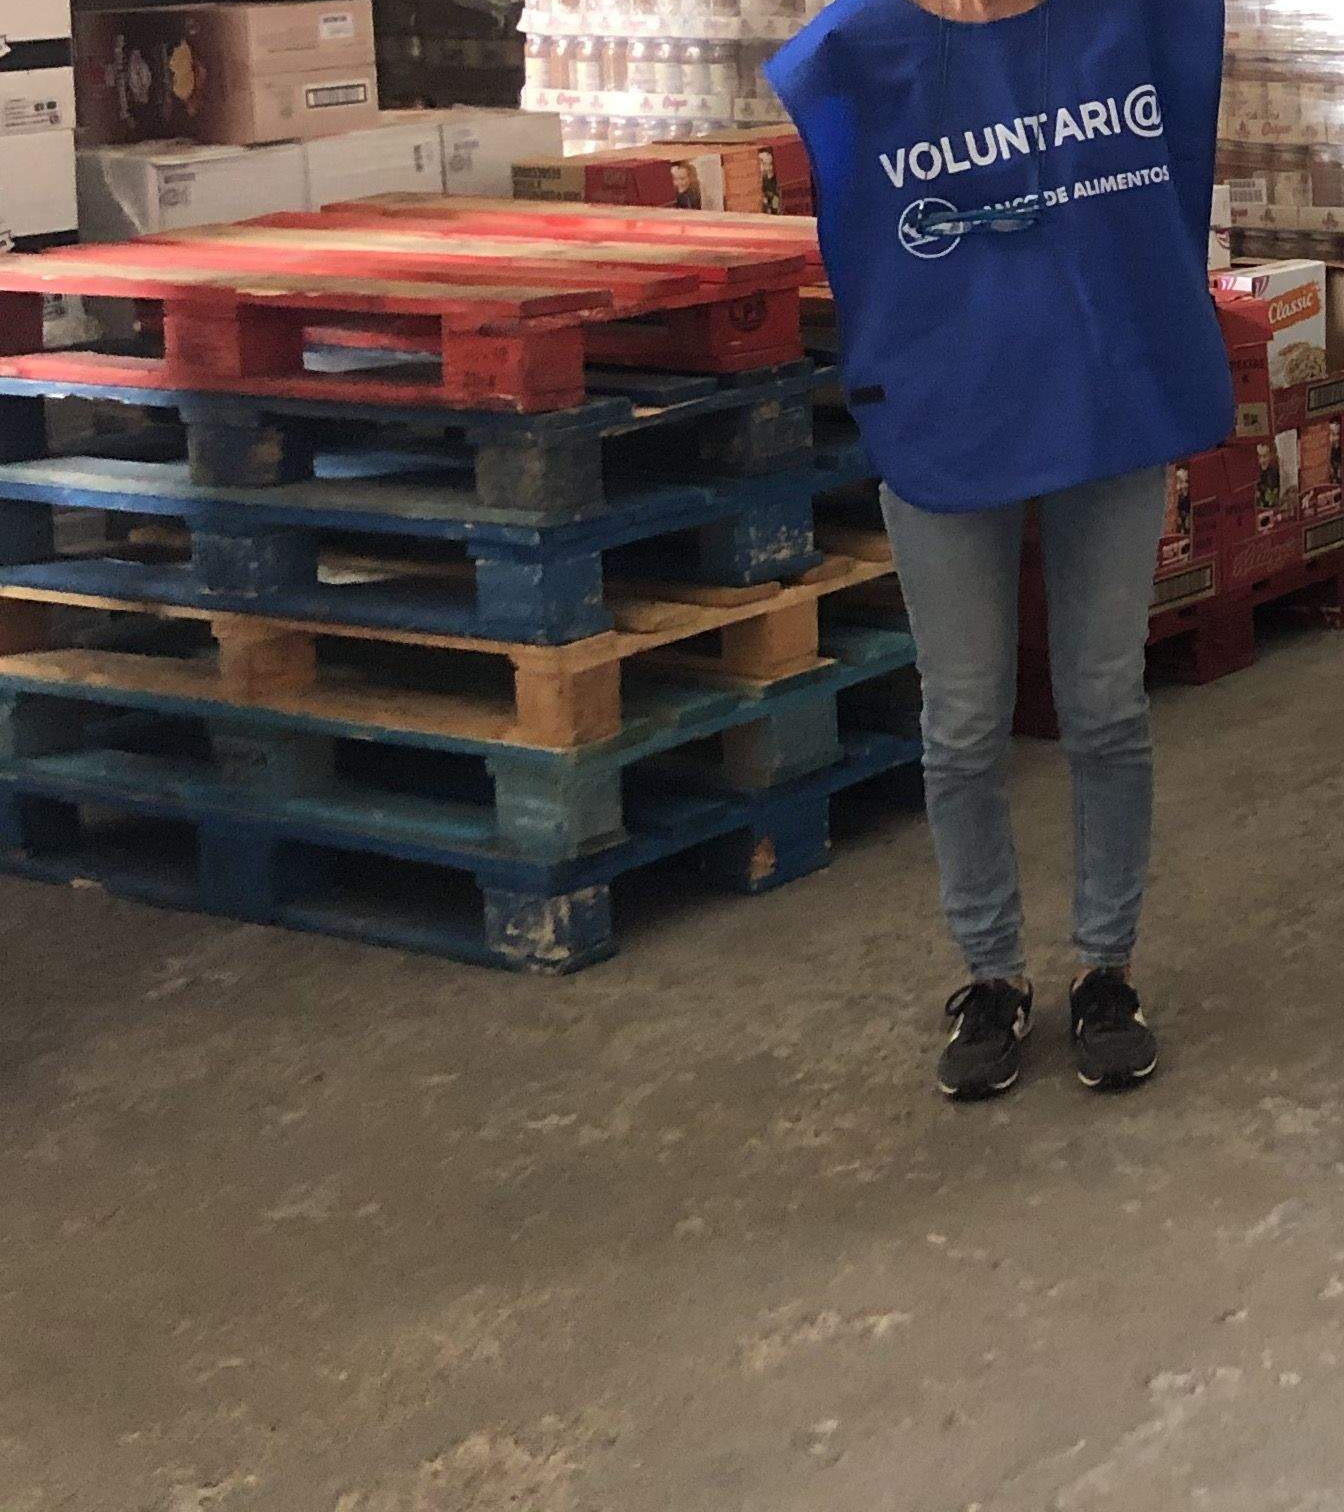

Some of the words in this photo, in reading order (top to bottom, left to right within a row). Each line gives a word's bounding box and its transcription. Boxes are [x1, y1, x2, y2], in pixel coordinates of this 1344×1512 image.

[879, 84, 1164, 189] VOLUNTARI@
[1043, 186, 1070, 207] DE
[1073, 164, 1170, 200] ALIMENTOS
[1268, 291, 1314, 325] Classic
